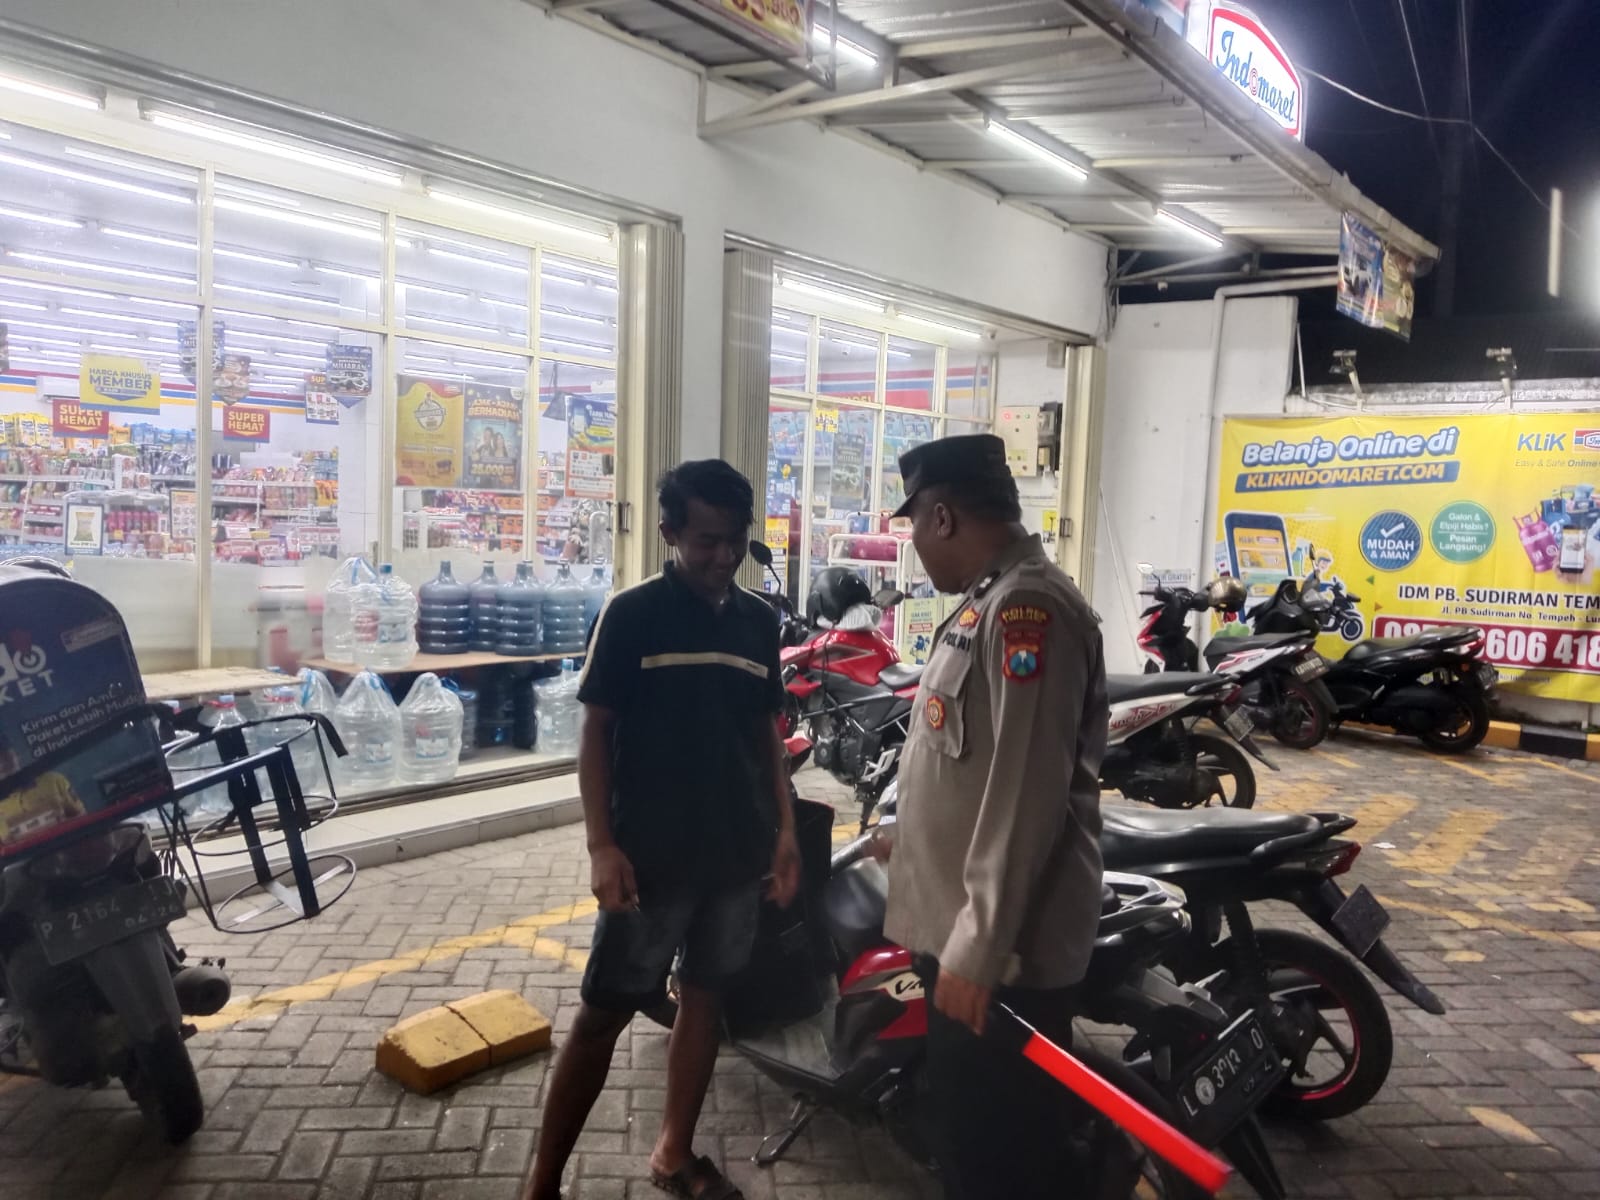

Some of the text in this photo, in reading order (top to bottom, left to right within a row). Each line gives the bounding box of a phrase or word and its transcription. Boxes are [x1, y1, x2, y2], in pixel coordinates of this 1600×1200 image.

[1216, 30, 1296, 122] Indomaret
[89, 375, 152, 390] MEMBER
[60, 415, 103, 427] HEMAT
[228, 411, 265, 423] SUPER
[228, 420, 265, 432] HEMAT
[1243, 427, 1457, 464] Belanja Online di
[1245, 463, 1445, 489] KLIKINDOMARET.COM
[1448, 512, 1473, 521] Galon
[1367, 539, 1415, 552] MUDAH
[1449, 534, 1477, 543] Pesan
[1440, 542, 1487, 553] Langsung!
[1370, 551, 1410, 560] & AMAN
[1399, 585, 1430, 599] IDM
[1435, 587, 1460, 602] PB.
[1465, 588, 1559, 607] SUDIRMAN
[1455, 607, 1468, 615] PB
[1470, 608, 1516, 618] Sudirman
[1538, 612, 1576, 623] Tempeh
[21, 711, 57, 735] Kirim
[60, 701, 87, 720] dan
[26, 722, 68, 746] Paket
[68, 704, 106, 731] Lebih
[40, 897, 122, 941] P 2164
[1182, 1095, 1200, 1117] L
